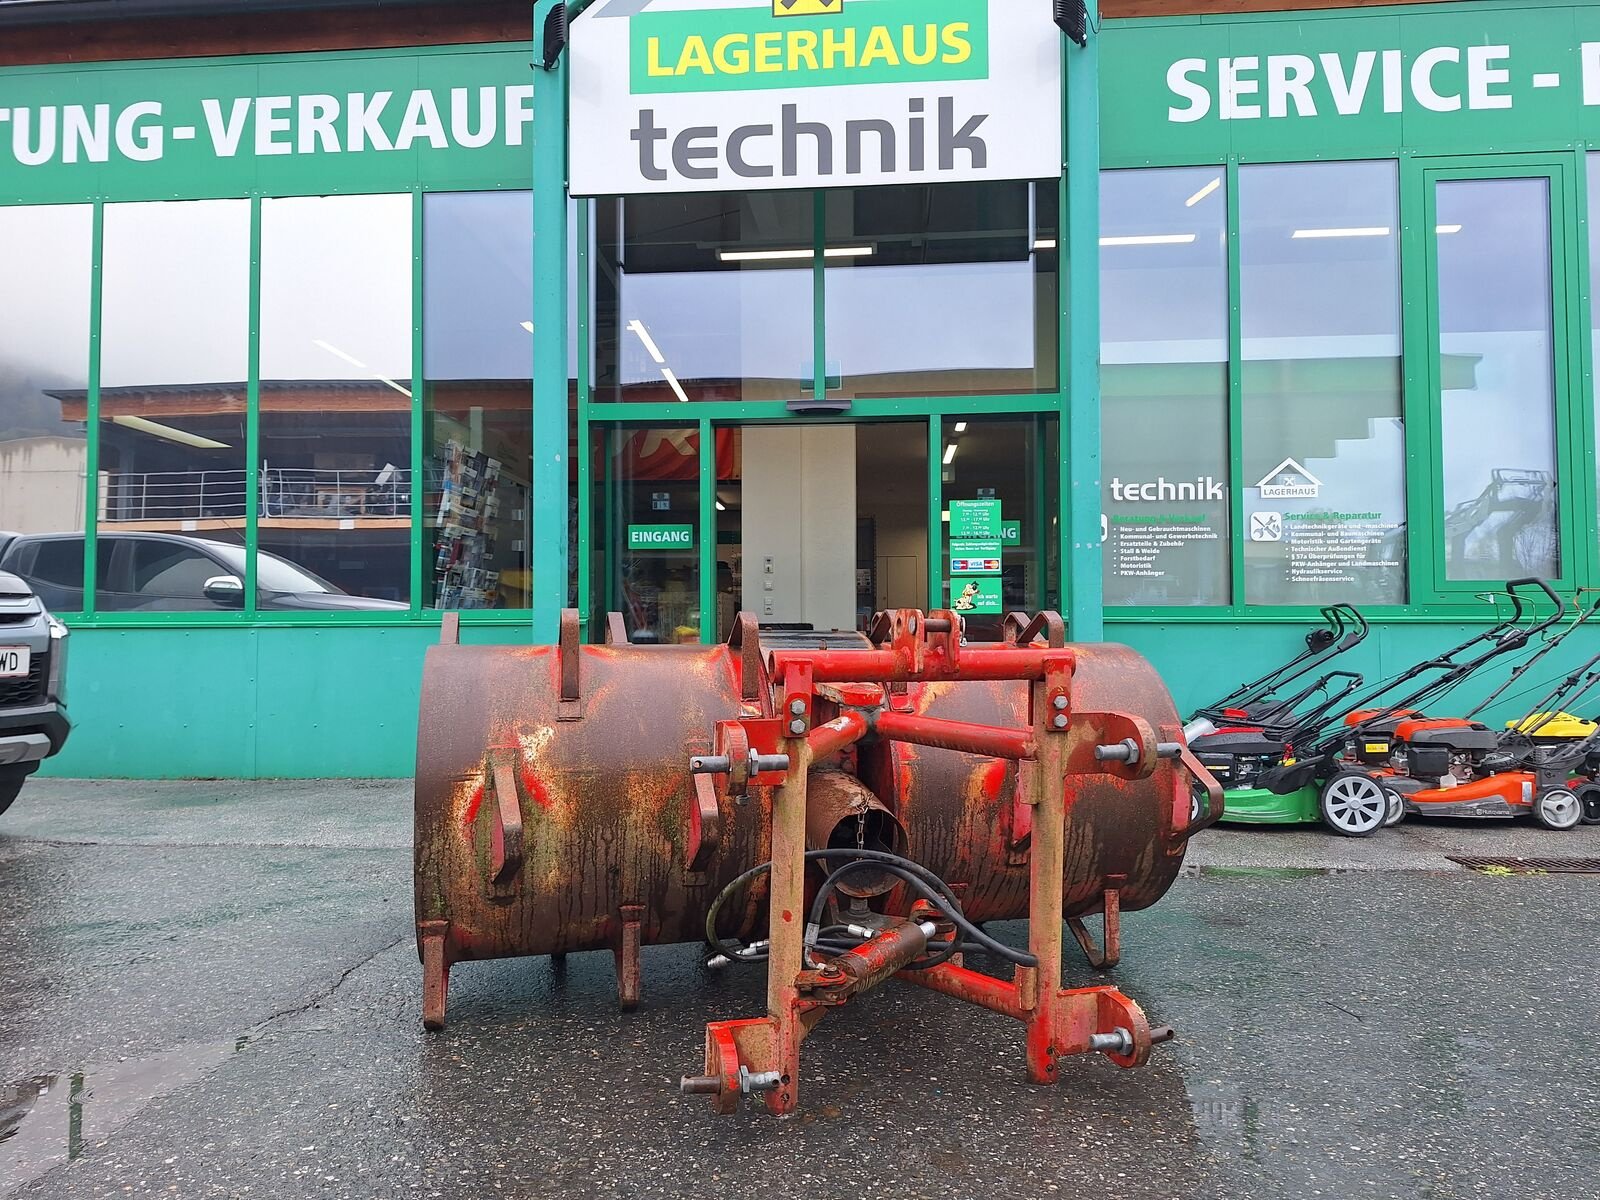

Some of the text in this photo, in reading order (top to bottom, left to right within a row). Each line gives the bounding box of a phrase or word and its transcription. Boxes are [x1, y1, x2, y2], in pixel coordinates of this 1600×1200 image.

[646, 22, 972, 77] LAGERHAUS
[1165, 45, 1513, 122] SERVICE
[0, 85, 534, 166] UNG-VERKAUF
[630, 96, 989, 181] technik
[1110, 476, 1224, 501] technik
[1263, 487, 1316, 496] LAGERHAUS
[1284, 512, 1320, 521] Service
[1333, 512, 1382, 521] Reparatur
[632, 531, 689, 542] EINGANG
[1308, 552, 1355, 560] Überprüfungen
